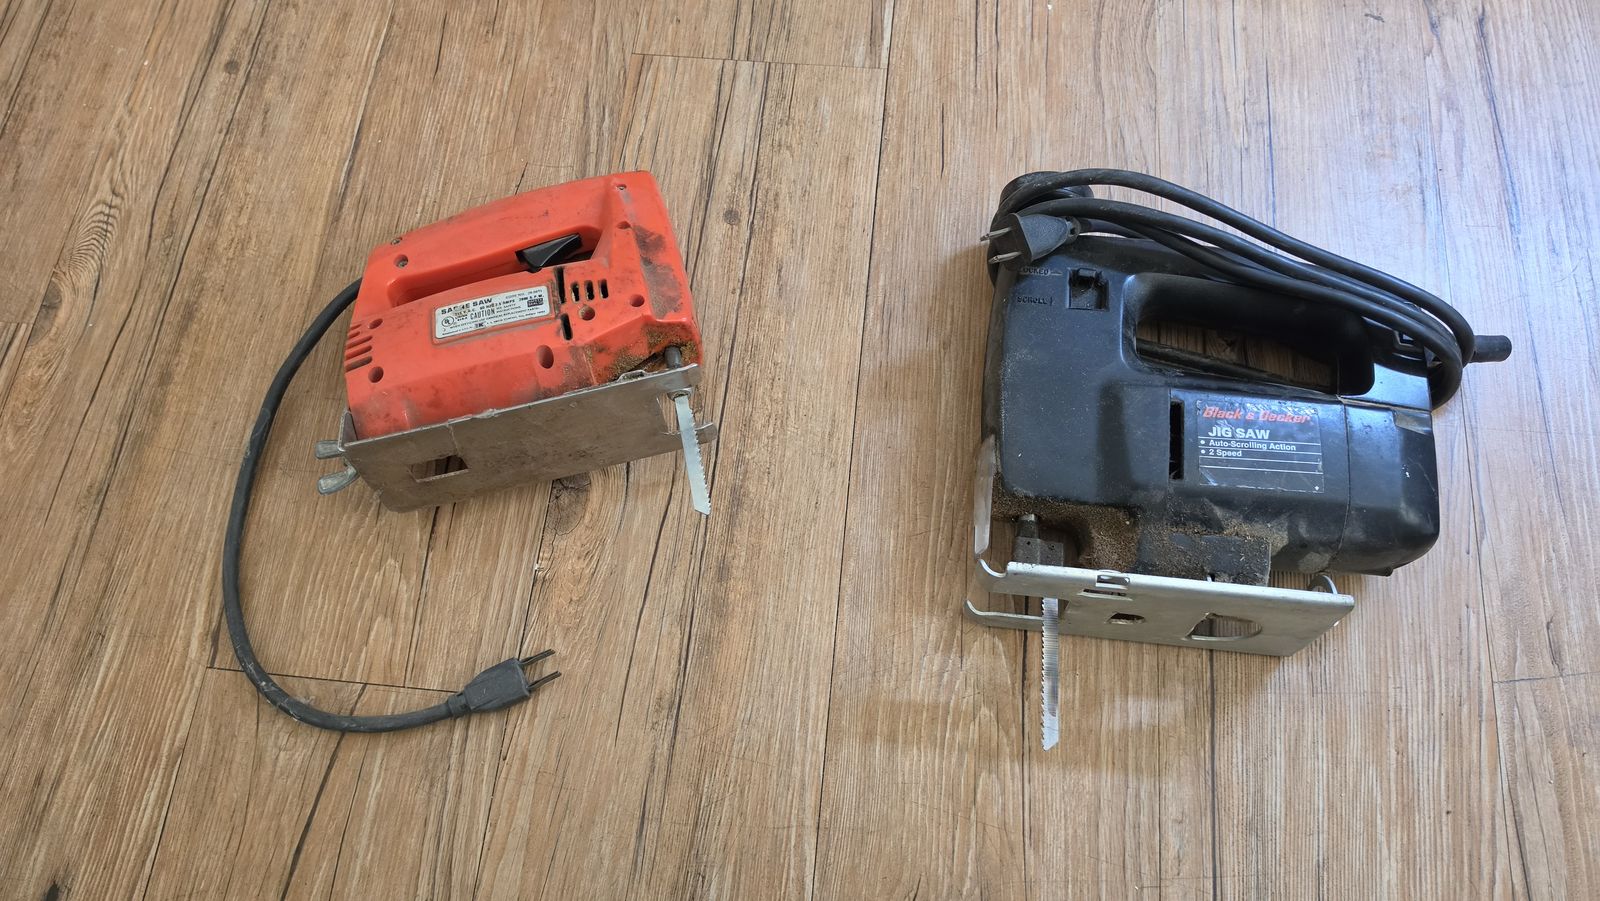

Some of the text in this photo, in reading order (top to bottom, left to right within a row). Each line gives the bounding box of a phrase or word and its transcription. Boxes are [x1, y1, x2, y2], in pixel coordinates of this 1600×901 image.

[472, 298, 493, 307] SAW
[1017, 296, 1048, 305] SCROLL
[470, 307, 496, 320] CAUTION
[1203, 407, 1241, 419] Black
[1259, 410, 1310, 423] Decker
[1208, 427, 1270, 440] JIG SAW
[1209, 439, 1297, 451] Auto-Scrolling Action
[1216, 449, 1242, 457] Speed
